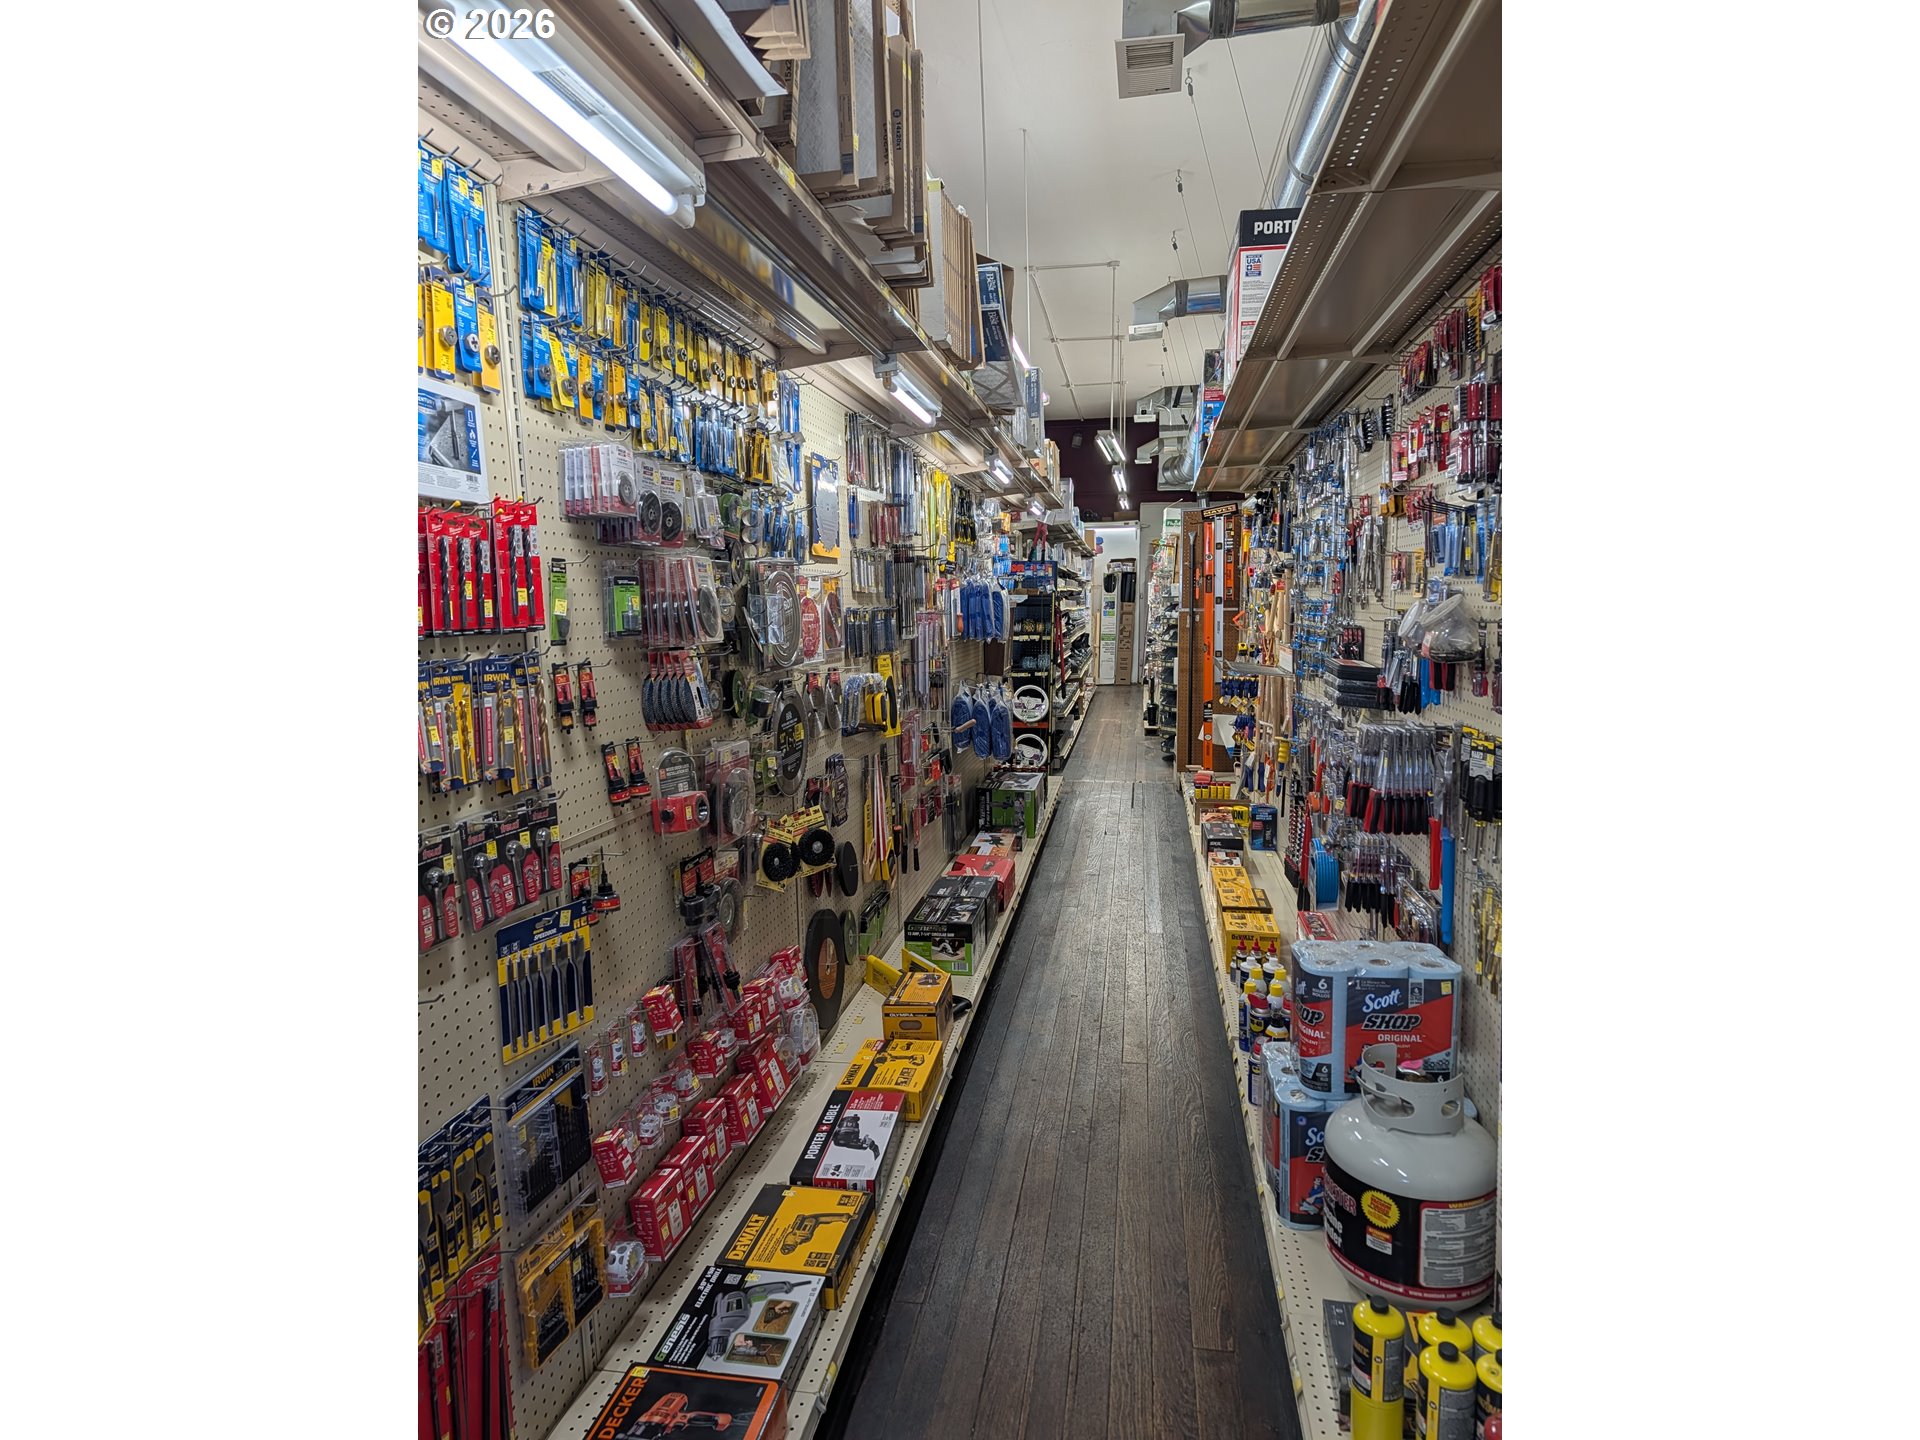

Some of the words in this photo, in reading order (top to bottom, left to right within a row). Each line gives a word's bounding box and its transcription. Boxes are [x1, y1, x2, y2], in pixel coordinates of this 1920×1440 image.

[785, 59, 793, 82] 15x2
[1253, 219, 1299, 235] PORTE
[433, 675, 451, 686] IRWIN
[484, 673, 509, 682] IRWIN
[1318, 978, 1328, 990] 6
[1362, 988, 1401, 1013] Scott
[1361, 1013, 1422, 1031] SHOP
[1377, 1034, 1423, 1042] ORIGINAL
[804, 1129, 828, 1160] PORTER
[822, 1103, 841, 1124] CABLE
[727, 1213, 767, 1260] DEWALT
[694, 1281, 714, 1309] ELECTRIC
[710, 1267, 723, 1284] DRILL
[598, 1376, 649, 1440] DECKER
